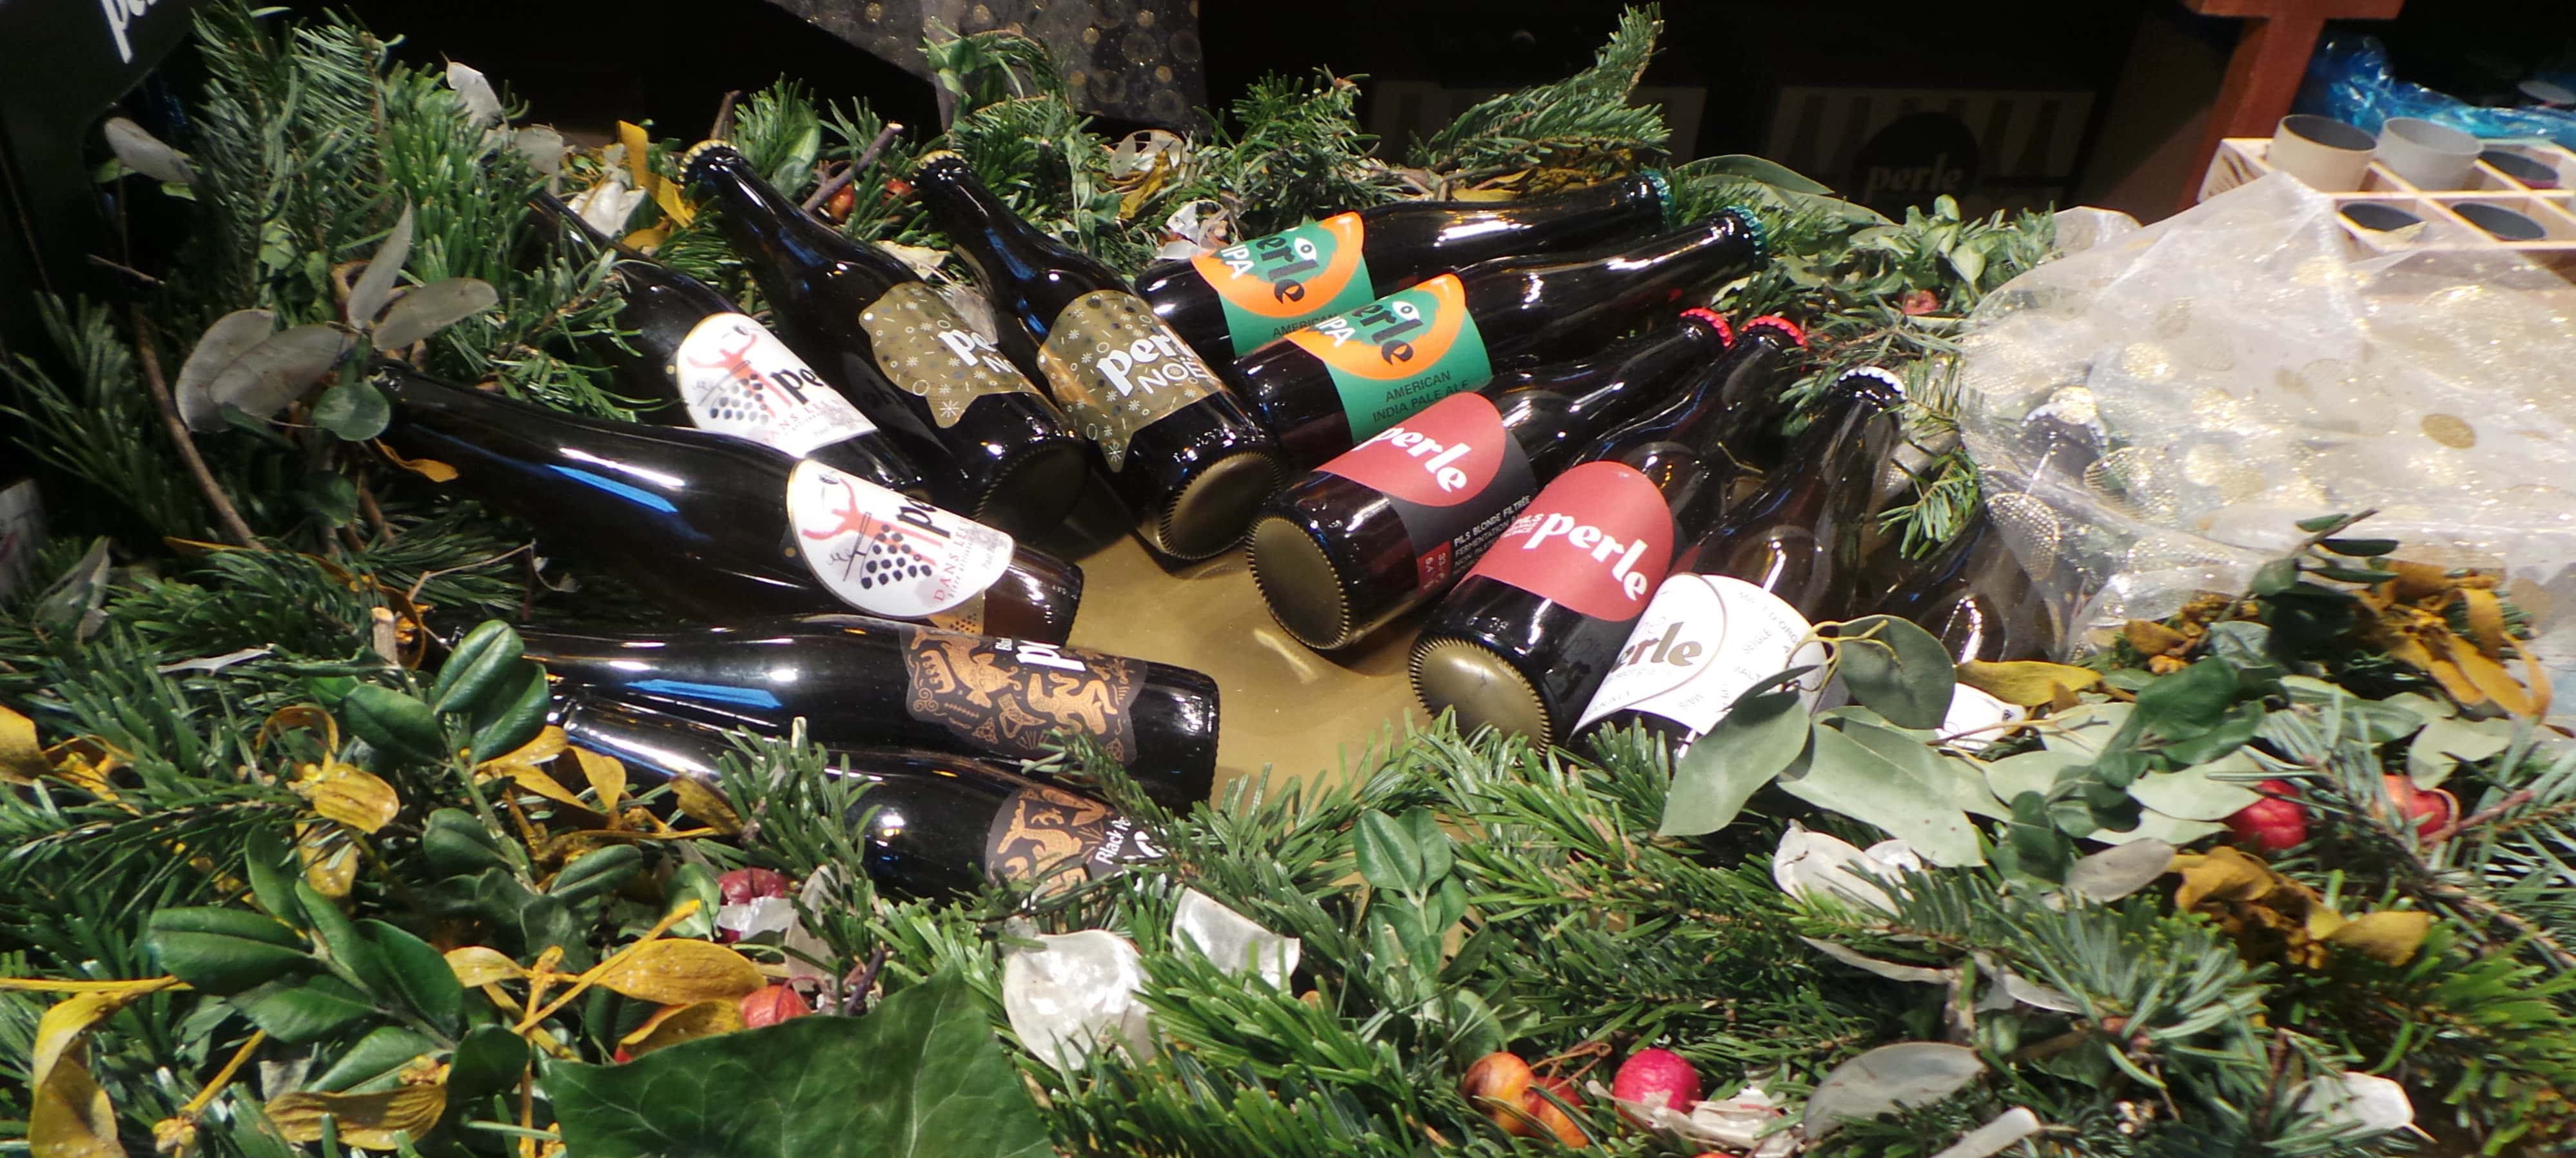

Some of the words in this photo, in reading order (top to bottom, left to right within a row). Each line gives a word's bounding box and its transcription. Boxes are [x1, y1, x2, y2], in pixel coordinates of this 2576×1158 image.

[1865, 152, 1964, 200] perle
[1220, 244, 1255, 279] IPA
[1316, 316, 1356, 348] IPA
[1386, 369, 1452, 403] AMERICAN
[1372, 402, 1409, 423] INDIA
[1412, 389, 1443, 409] PALE
[1354, 426, 1472, 493] perle
[1453, 531, 1471, 547] PILS
[1472, 513, 1501, 536] BLONDE
[1521, 512, 1648, 601] perle
[933, 552, 960, 603] DANS
[1769, 611, 1800, 644] D'ORG
[1095, 830, 1124, 865] Black
